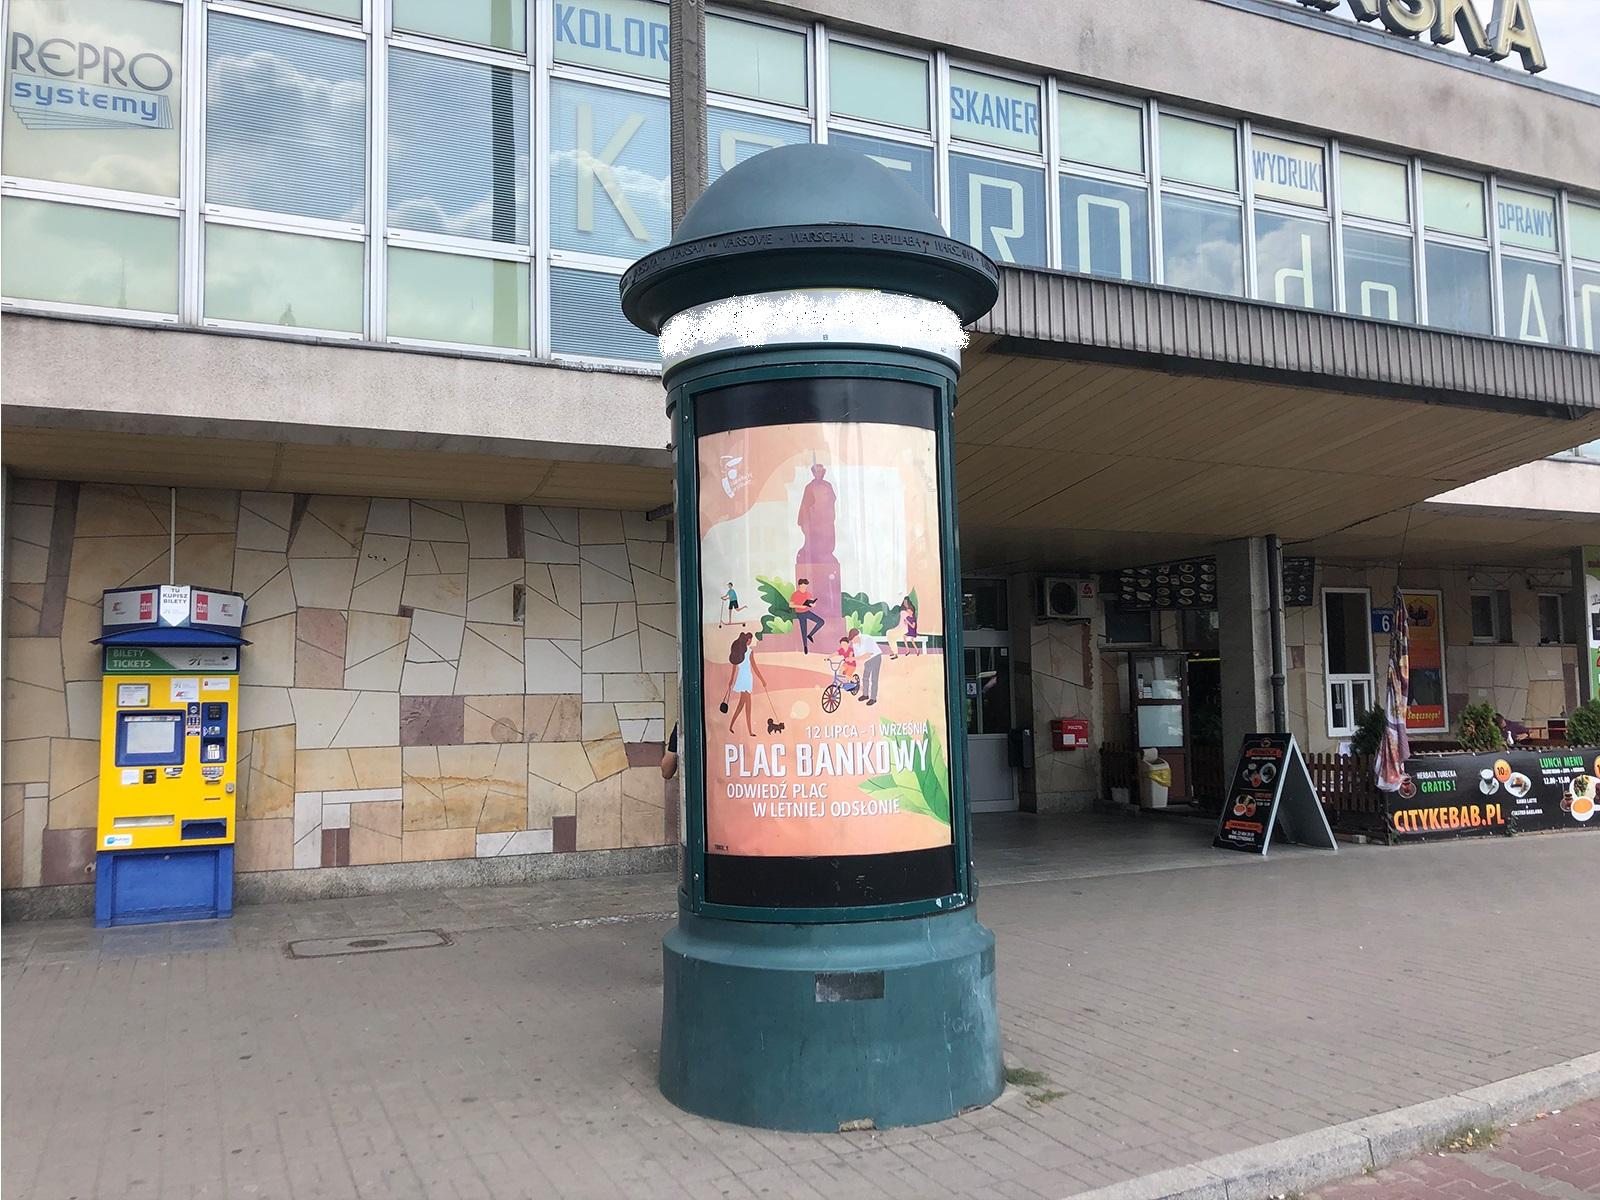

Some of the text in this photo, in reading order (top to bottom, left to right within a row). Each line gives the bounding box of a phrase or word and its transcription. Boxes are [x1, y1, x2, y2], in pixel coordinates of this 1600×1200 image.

[555, 3, 670, 62] KOLOR
[11, 31, 173, 92] REPRO
[14, 81, 158, 122] systemy
[949, 85, 1039, 136] SKANER
[1252, 149, 1323, 193] WYDRUKI
[1497, 201, 1553, 238] OPRAWY
[1381, 614, 1390, 632] 6
[113, 649, 144, 657] BILETY
[113, 659, 151, 668] TICKETS
[806, 725, 820, 739] 12
[824, 724, 858, 739] LIPCA
[879, 721, 929, 736] WRZEŚNIA
[724, 738, 929, 778] PLAC BANKOWY
[1539, 757, 1562, 769] LUNCH
[1563, 756, 1584, 767] MENU
[1416, 771, 1436, 780] HERBATA
[727, 781, 828, 800] ODWIEDŹ PLAC
[1421, 780, 1451, 793] GRATIS
[753, 799, 901, 818] W LETNIEJ ODSŁONIE
[1393, 803, 1505, 833] CITYKEBAB.PL
